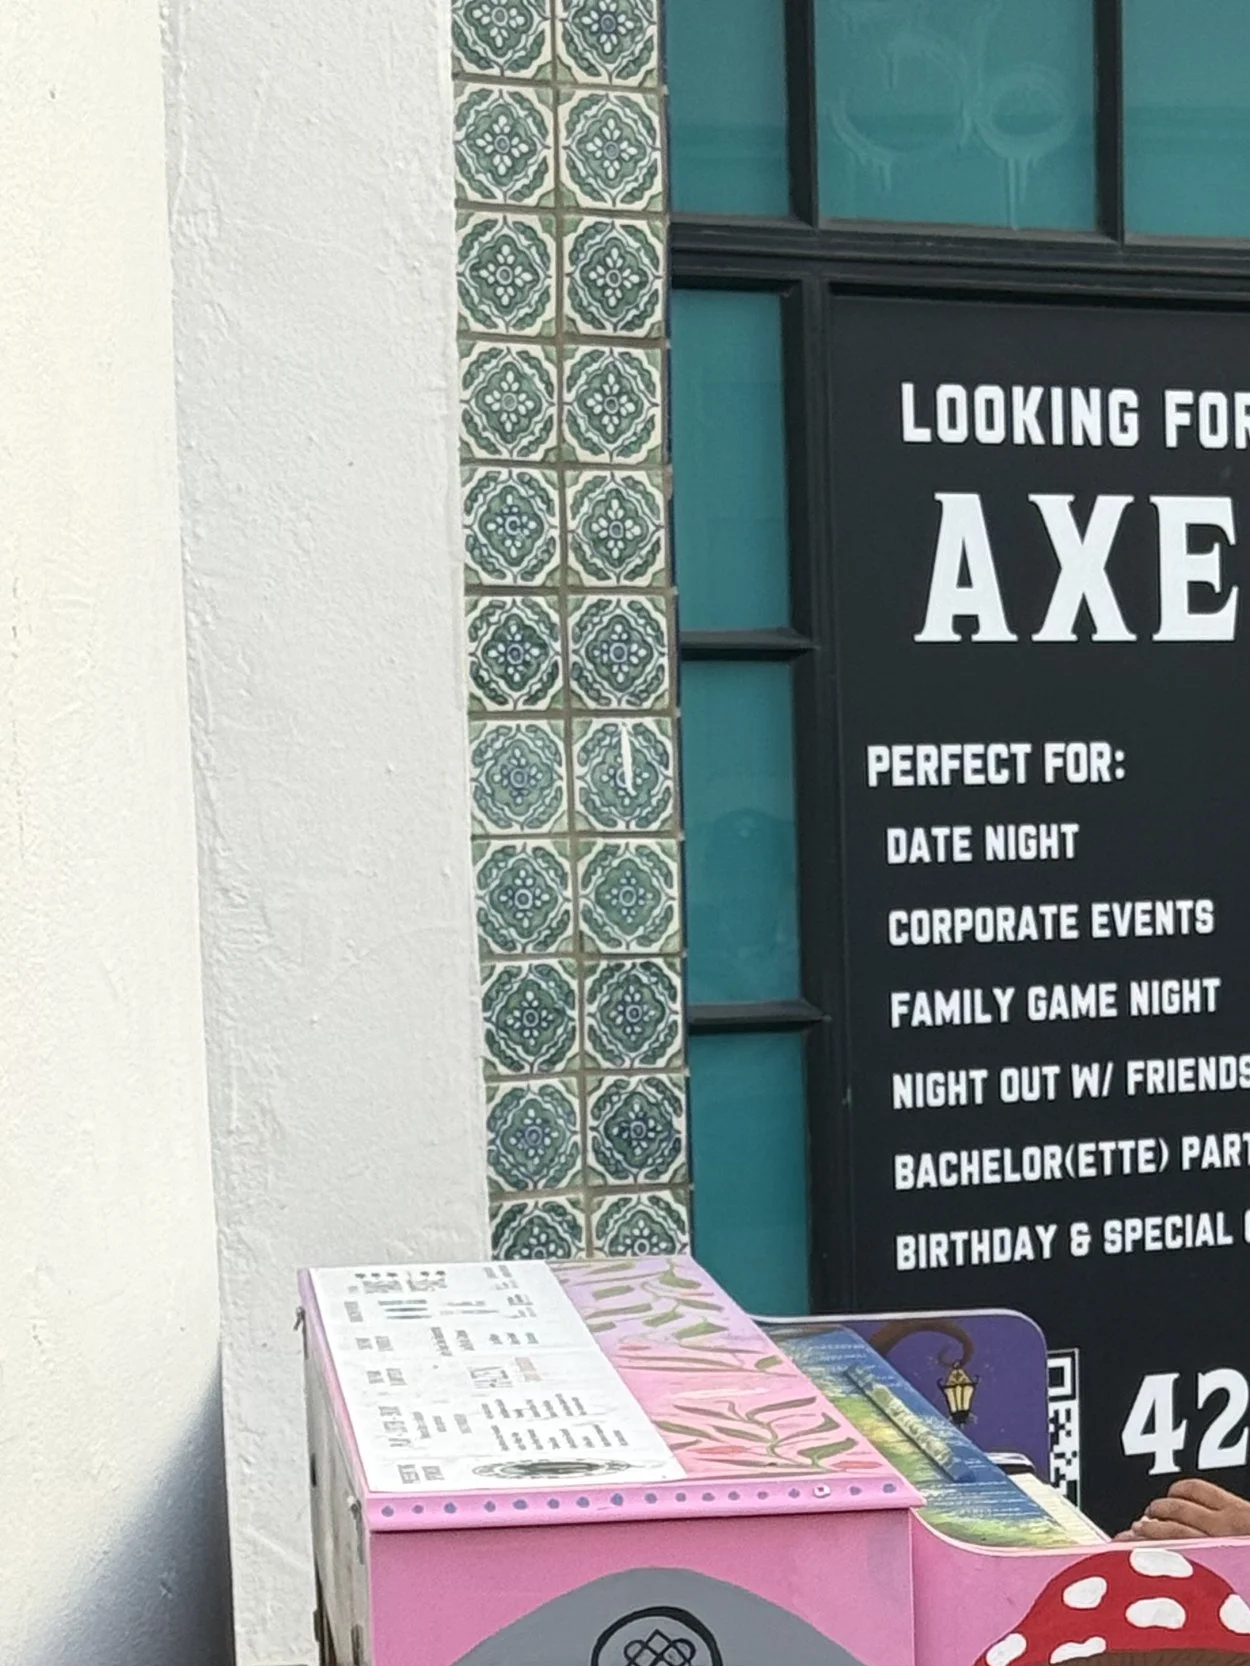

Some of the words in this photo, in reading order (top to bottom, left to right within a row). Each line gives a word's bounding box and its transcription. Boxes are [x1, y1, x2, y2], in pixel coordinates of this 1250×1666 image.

[901, 382, 1140, 447] LOOKING
[913, 492, 1239, 642] AXE
[867, 742, 1032, 787] PERFECT
[1044, 741, 1125, 784] FOR:
[886, 825, 973, 864] DATE
[985, 823, 1080, 861] NIGHT
[888, 903, 1079, 946] CORPORATE
[1091, 898, 1214, 938] EVENTS
[890, 987, 1016, 1028] FAMILY
[1027, 982, 1118, 1021] GAME
[1130, 977, 1221, 1016] NIGHT
[892, 1068, 989, 1110] NIGHT
[1000, 1064, 1061, 1103] OUT
[1071, 1061, 1114, 1099] W/
[894, 1138, 1169, 1190] BACHELOR(ETTE)
[896, 1224, 1058, 1271] BIRTHDAY
[1070, 1221, 1092, 1257] &
[1103, 1211, 1234, 1254] SPECIAL
